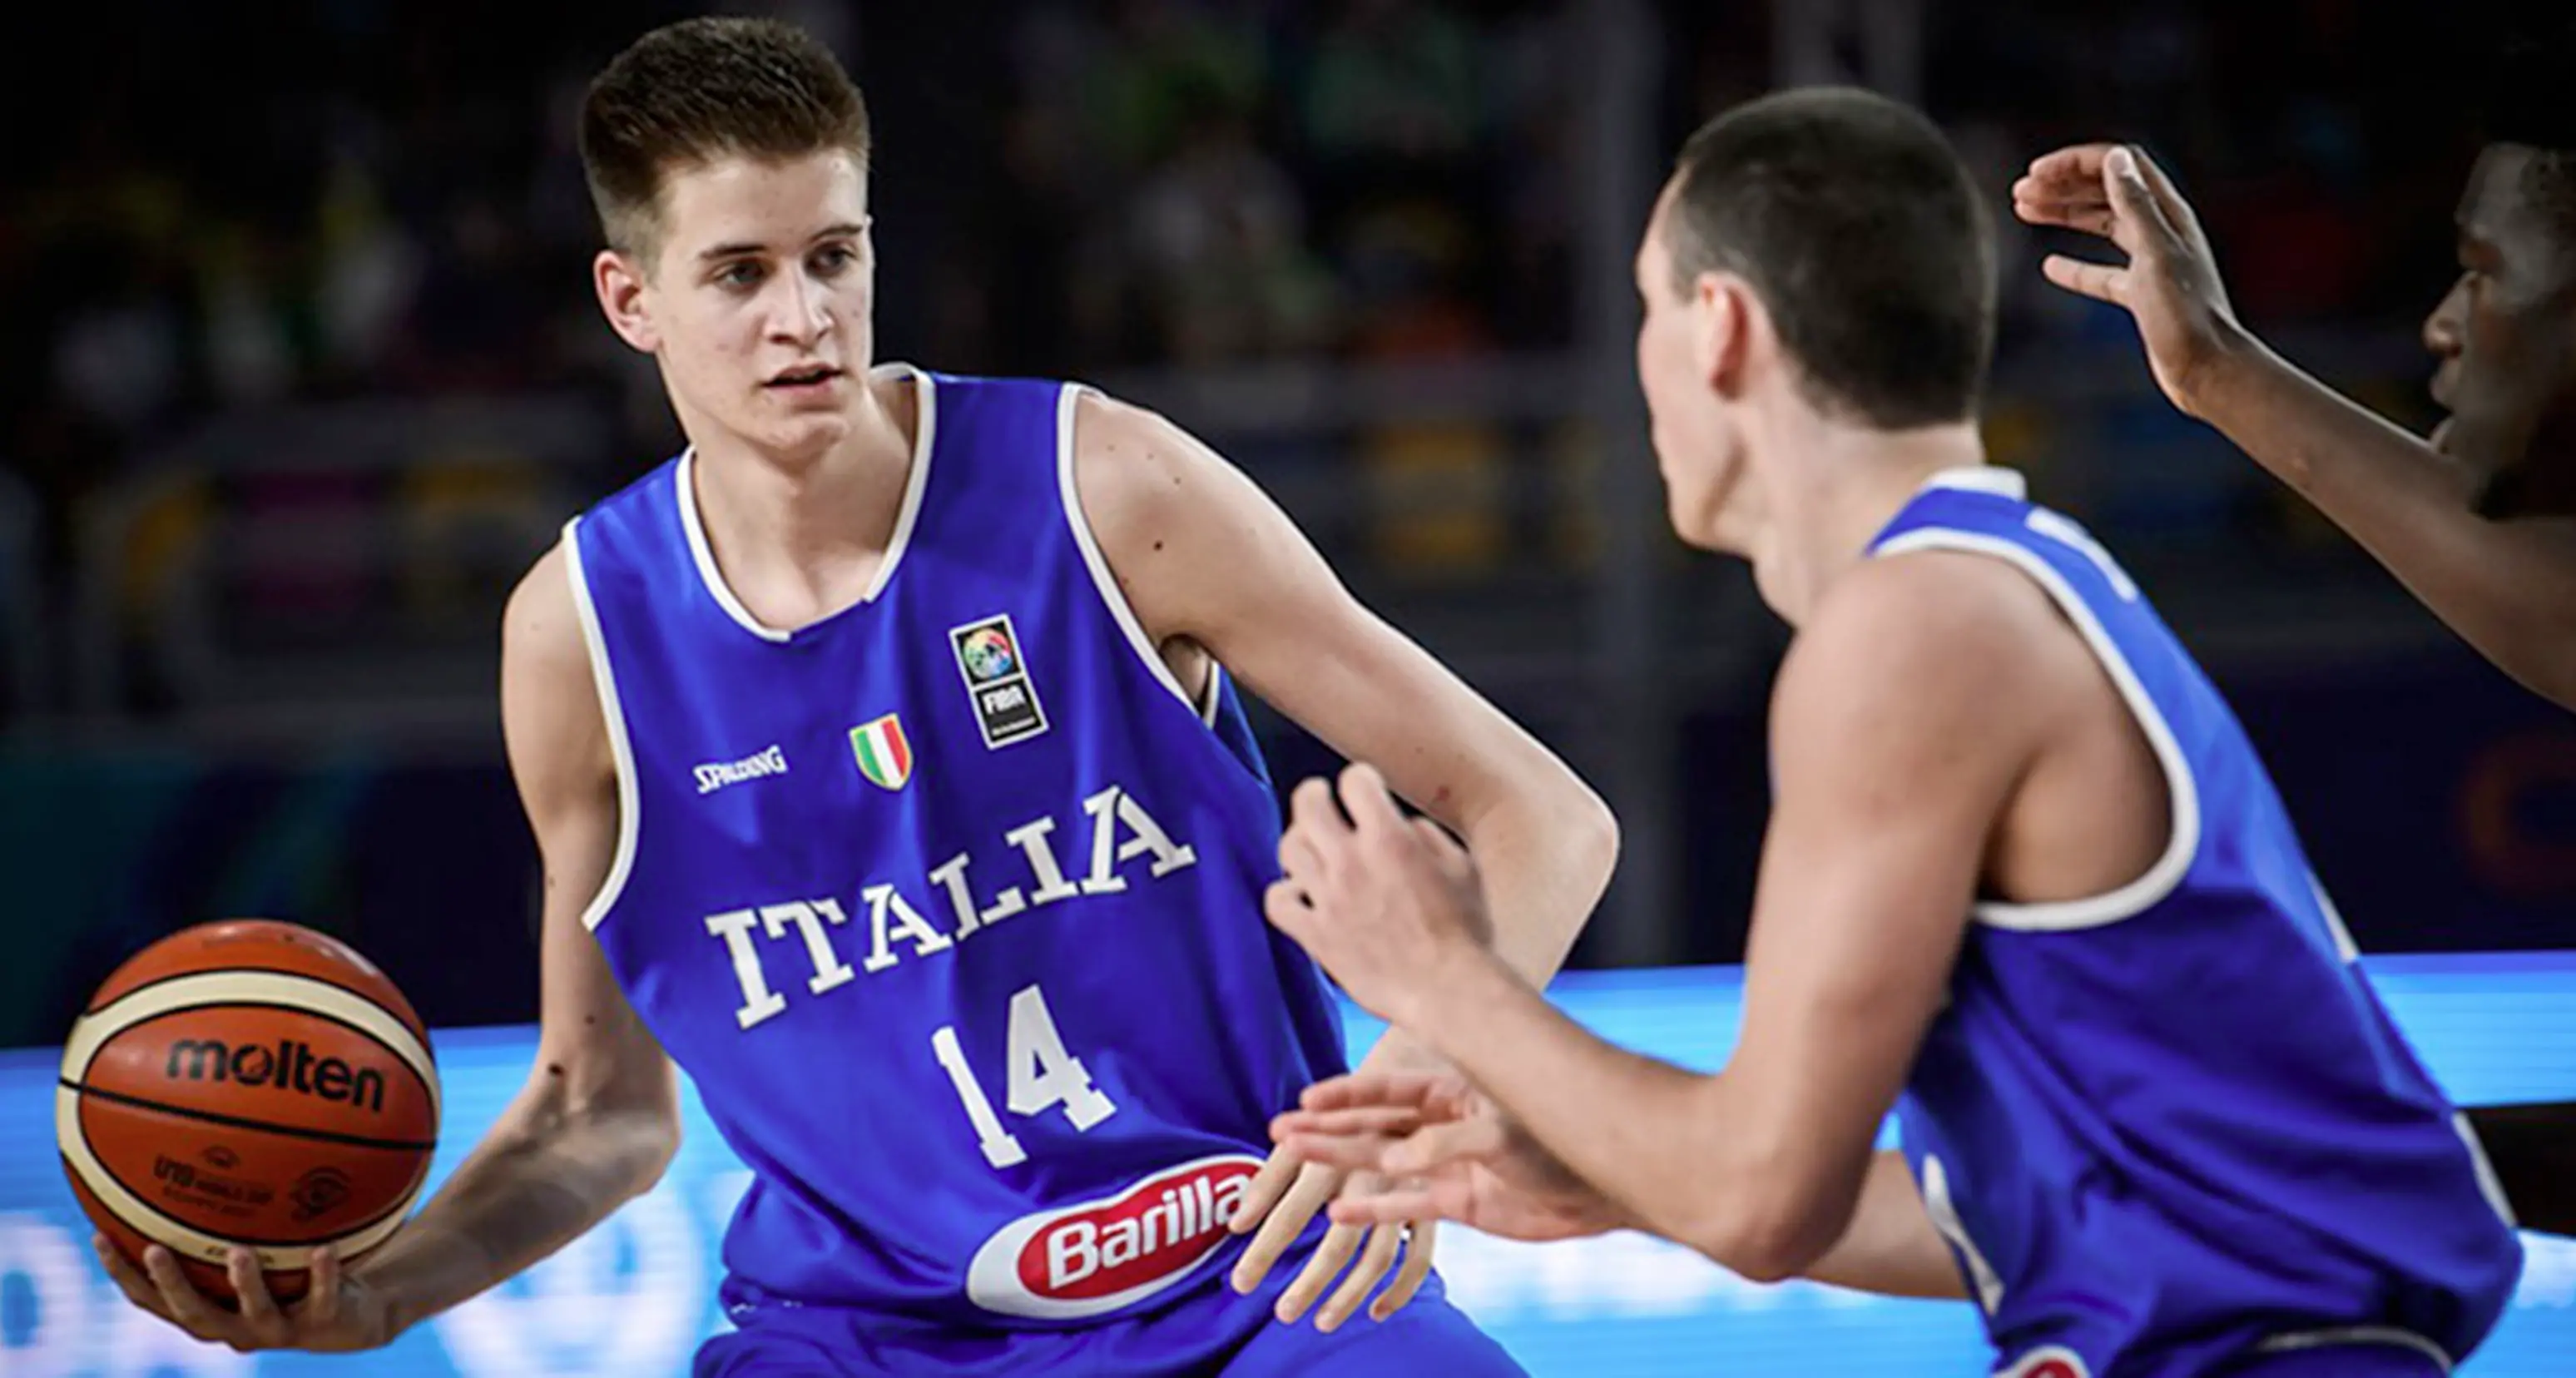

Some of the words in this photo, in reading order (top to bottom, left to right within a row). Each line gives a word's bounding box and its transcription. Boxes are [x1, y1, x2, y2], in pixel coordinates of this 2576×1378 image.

[694, 745, 787, 793] SPALDING
[704, 785, 1196, 1030] ITALIA
[166, 1039, 385, 1112] molten
[931, 984, 1117, 1169] 14
[1048, 1173, 1250, 1290] Barilla
